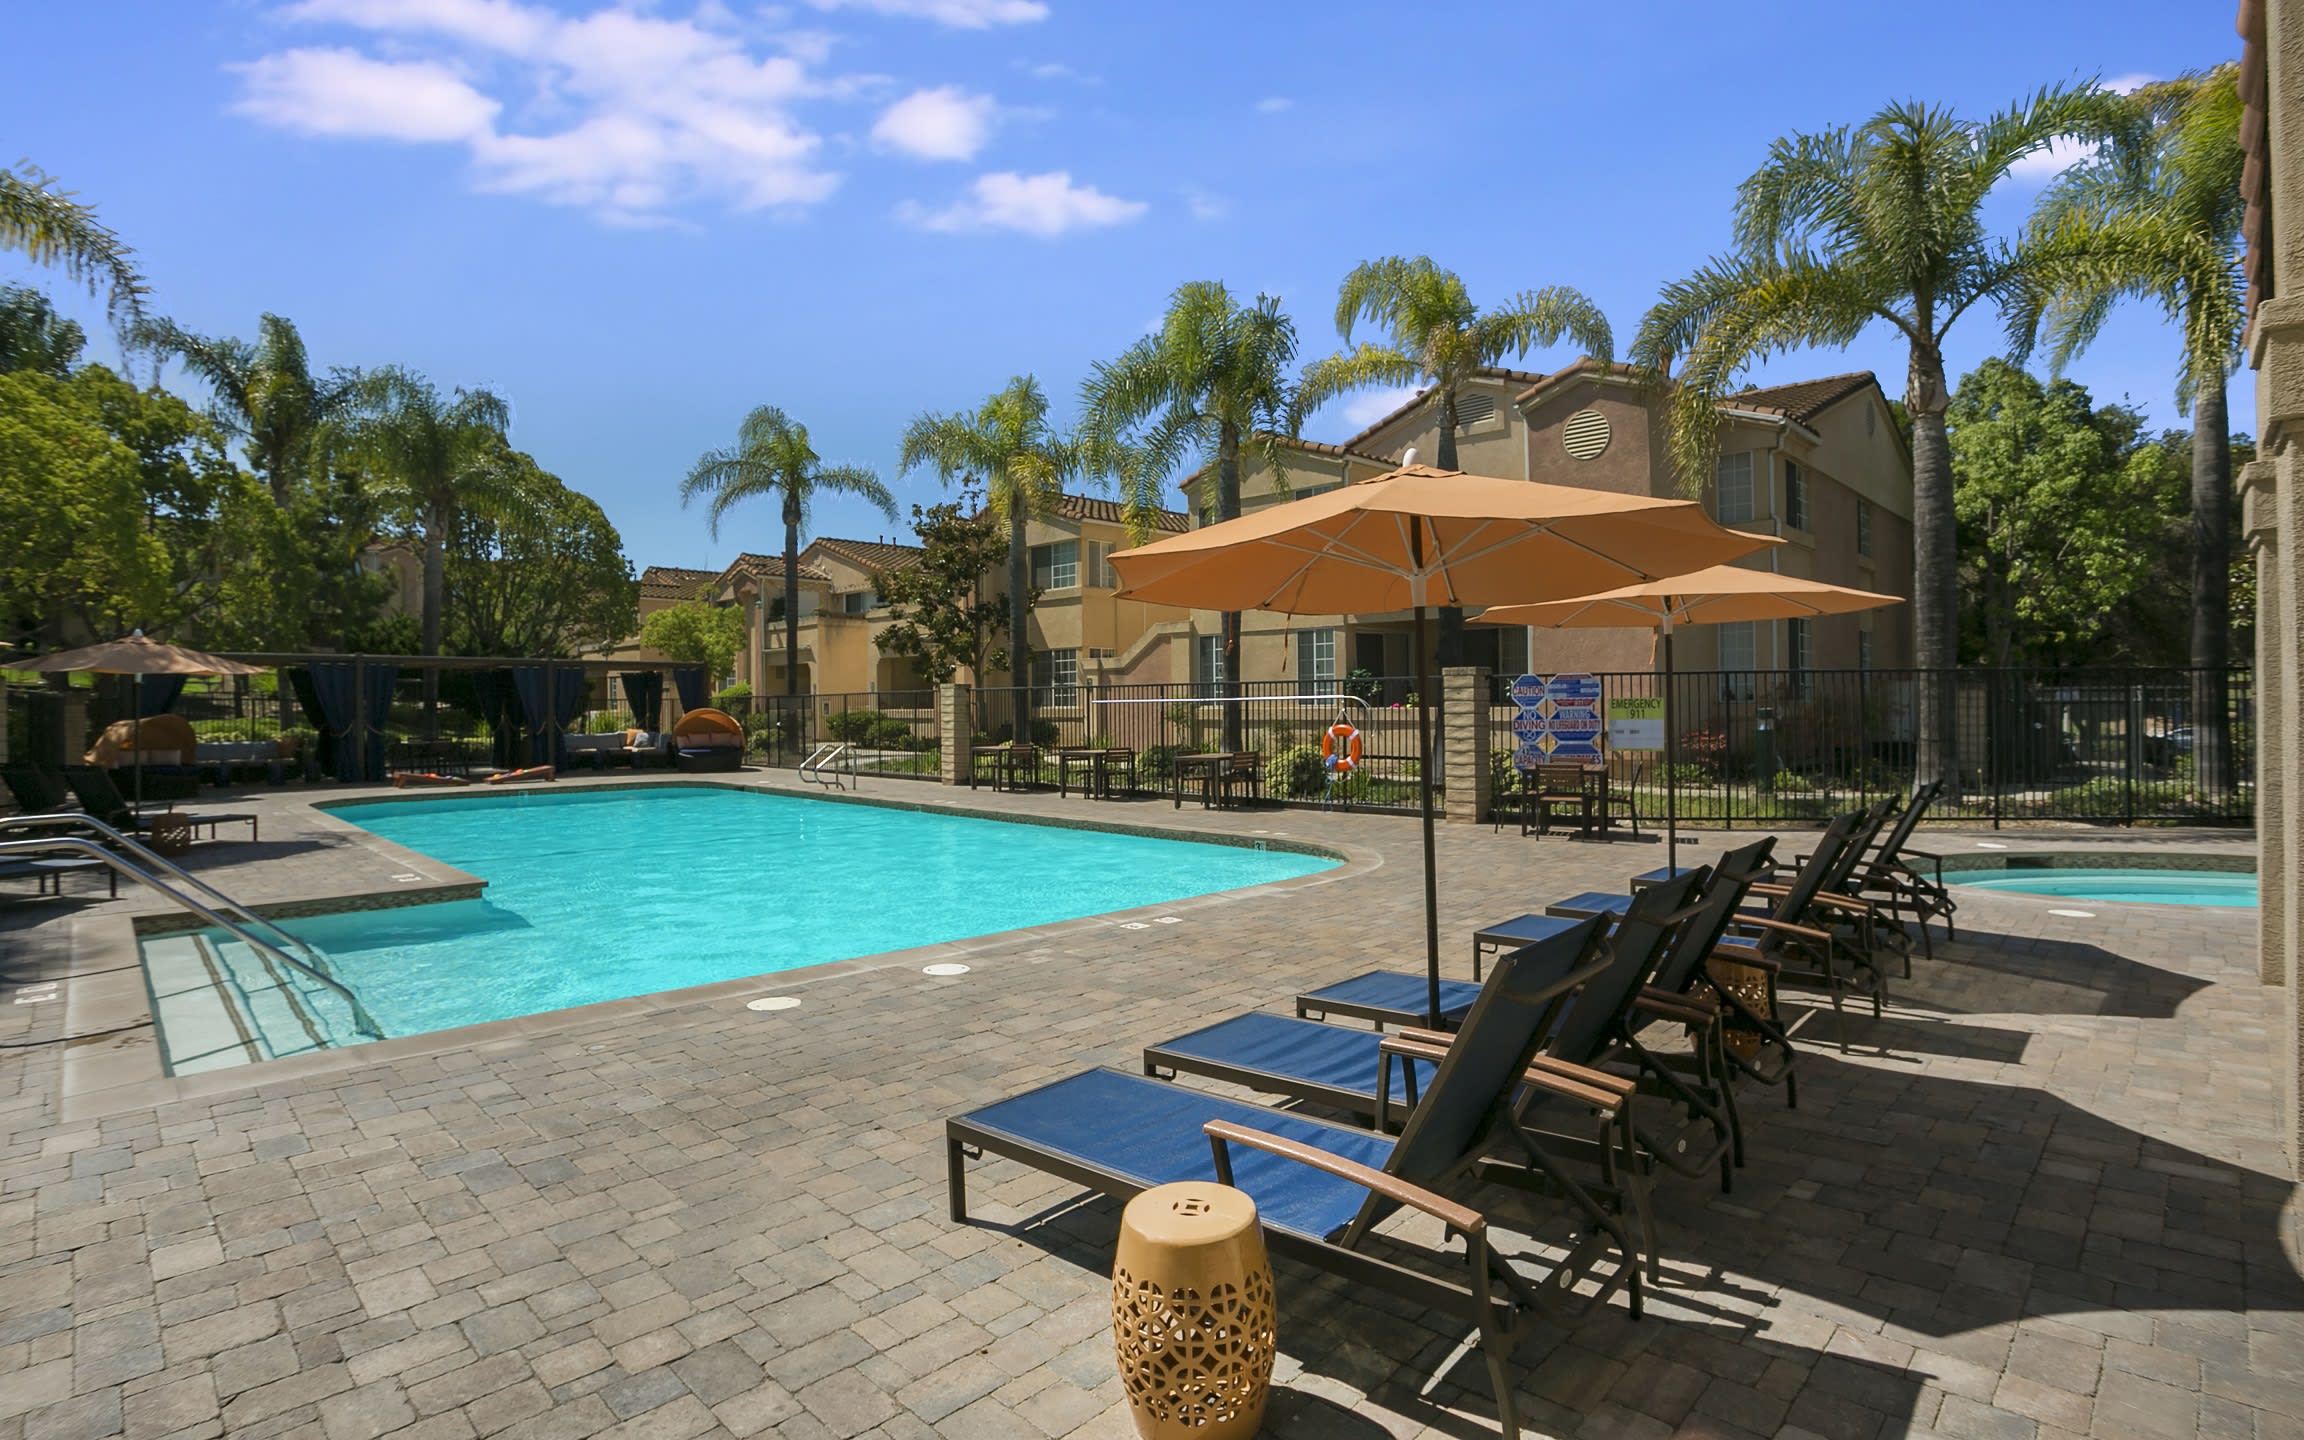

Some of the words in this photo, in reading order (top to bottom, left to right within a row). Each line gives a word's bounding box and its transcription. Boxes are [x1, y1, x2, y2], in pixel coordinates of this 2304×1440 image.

[1513, 686, 1545, 697] CAUTION
[1611, 698, 1662, 709] EMERGENCY
[1523, 710, 1537, 720] NO
[1560, 710, 1590, 720] WARNING
[1630, 709, 1645, 720] 911
[1513, 720, 1546, 730] DIVING
[1549, 720, 1556, 730] NO
[1557, 720, 1580, 730] LIFEGUARD
[1581, 720, 1588, 730] ON
[1589, 720, 1600, 730] DUTY
[1514, 754, 1545, 765] CAPACITY
